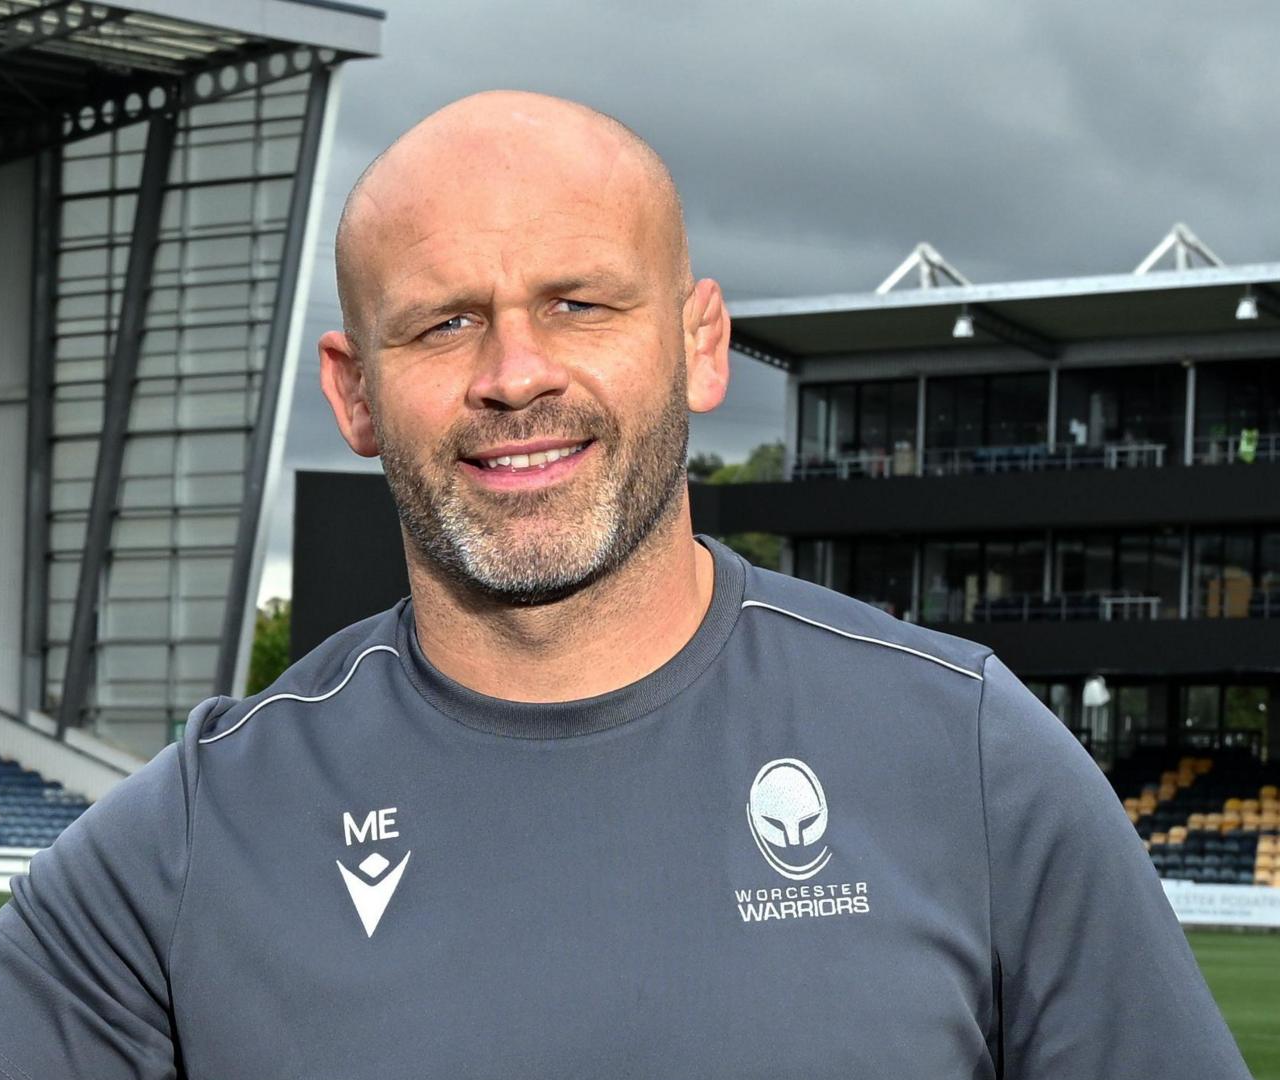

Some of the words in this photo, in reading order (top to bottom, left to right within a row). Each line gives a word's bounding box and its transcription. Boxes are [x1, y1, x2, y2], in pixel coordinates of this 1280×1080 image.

[343, 807, 400, 846] ME
[735, 882, 867, 903] WORCESTER
[738, 896, 870, 922] WARRIORS
